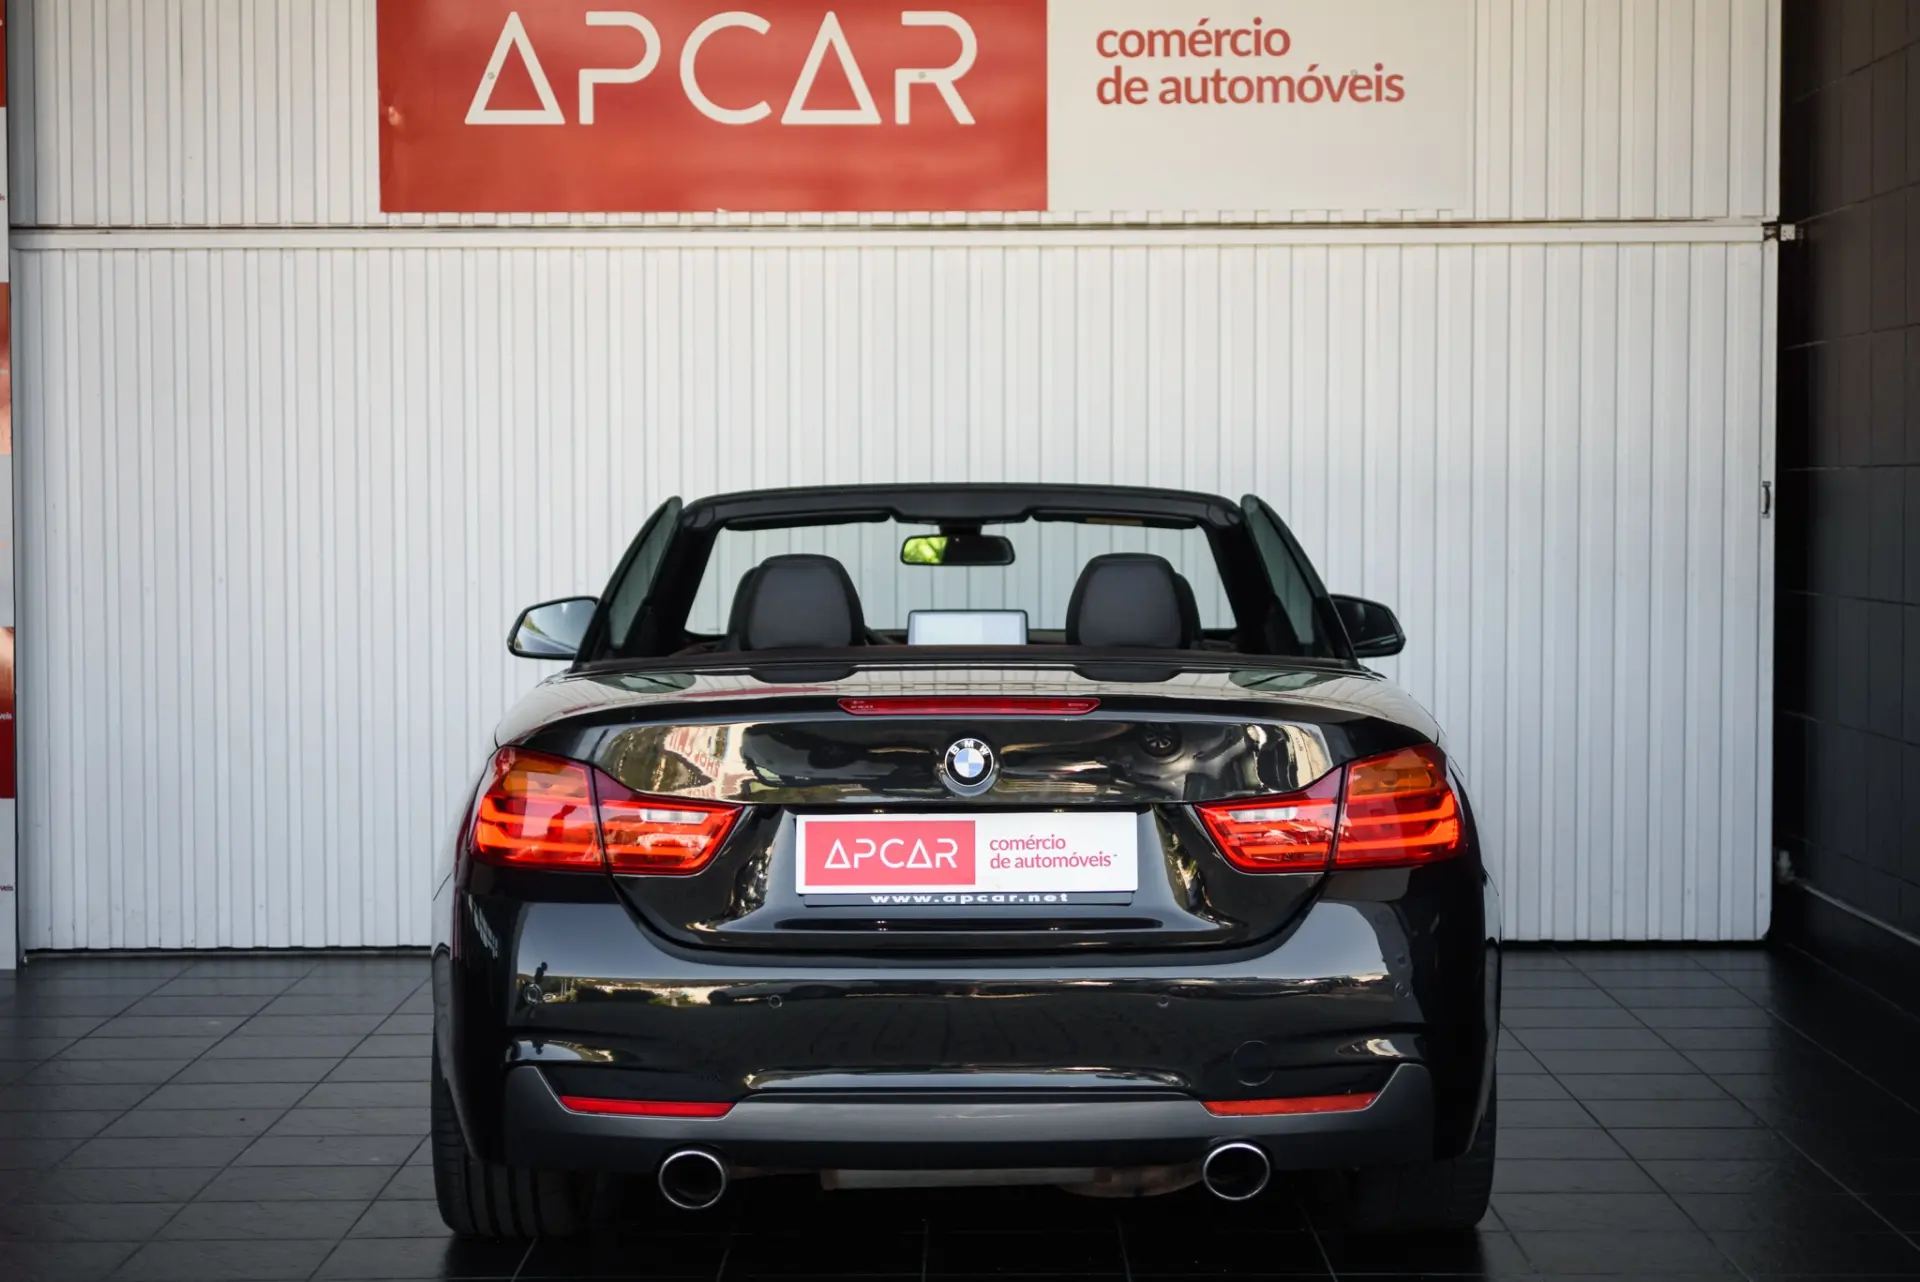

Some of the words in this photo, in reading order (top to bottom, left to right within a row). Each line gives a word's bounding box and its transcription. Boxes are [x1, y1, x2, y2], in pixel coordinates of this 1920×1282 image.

[1096, 17, 1291, 58] comércio
[464, 11, 977, 125] APCAR
[1096, 65, 1149, 105] de
[1158, 63, 1405, 105] automóveis
[824, 838, 958, 869] APCAR
[989, 834, 1066, 851] comércio
[990, 853, 1011, 869] de
[1014, 851, 1111, 869] automóveis
[871, 893, 1069, 905] www.apcar.net
